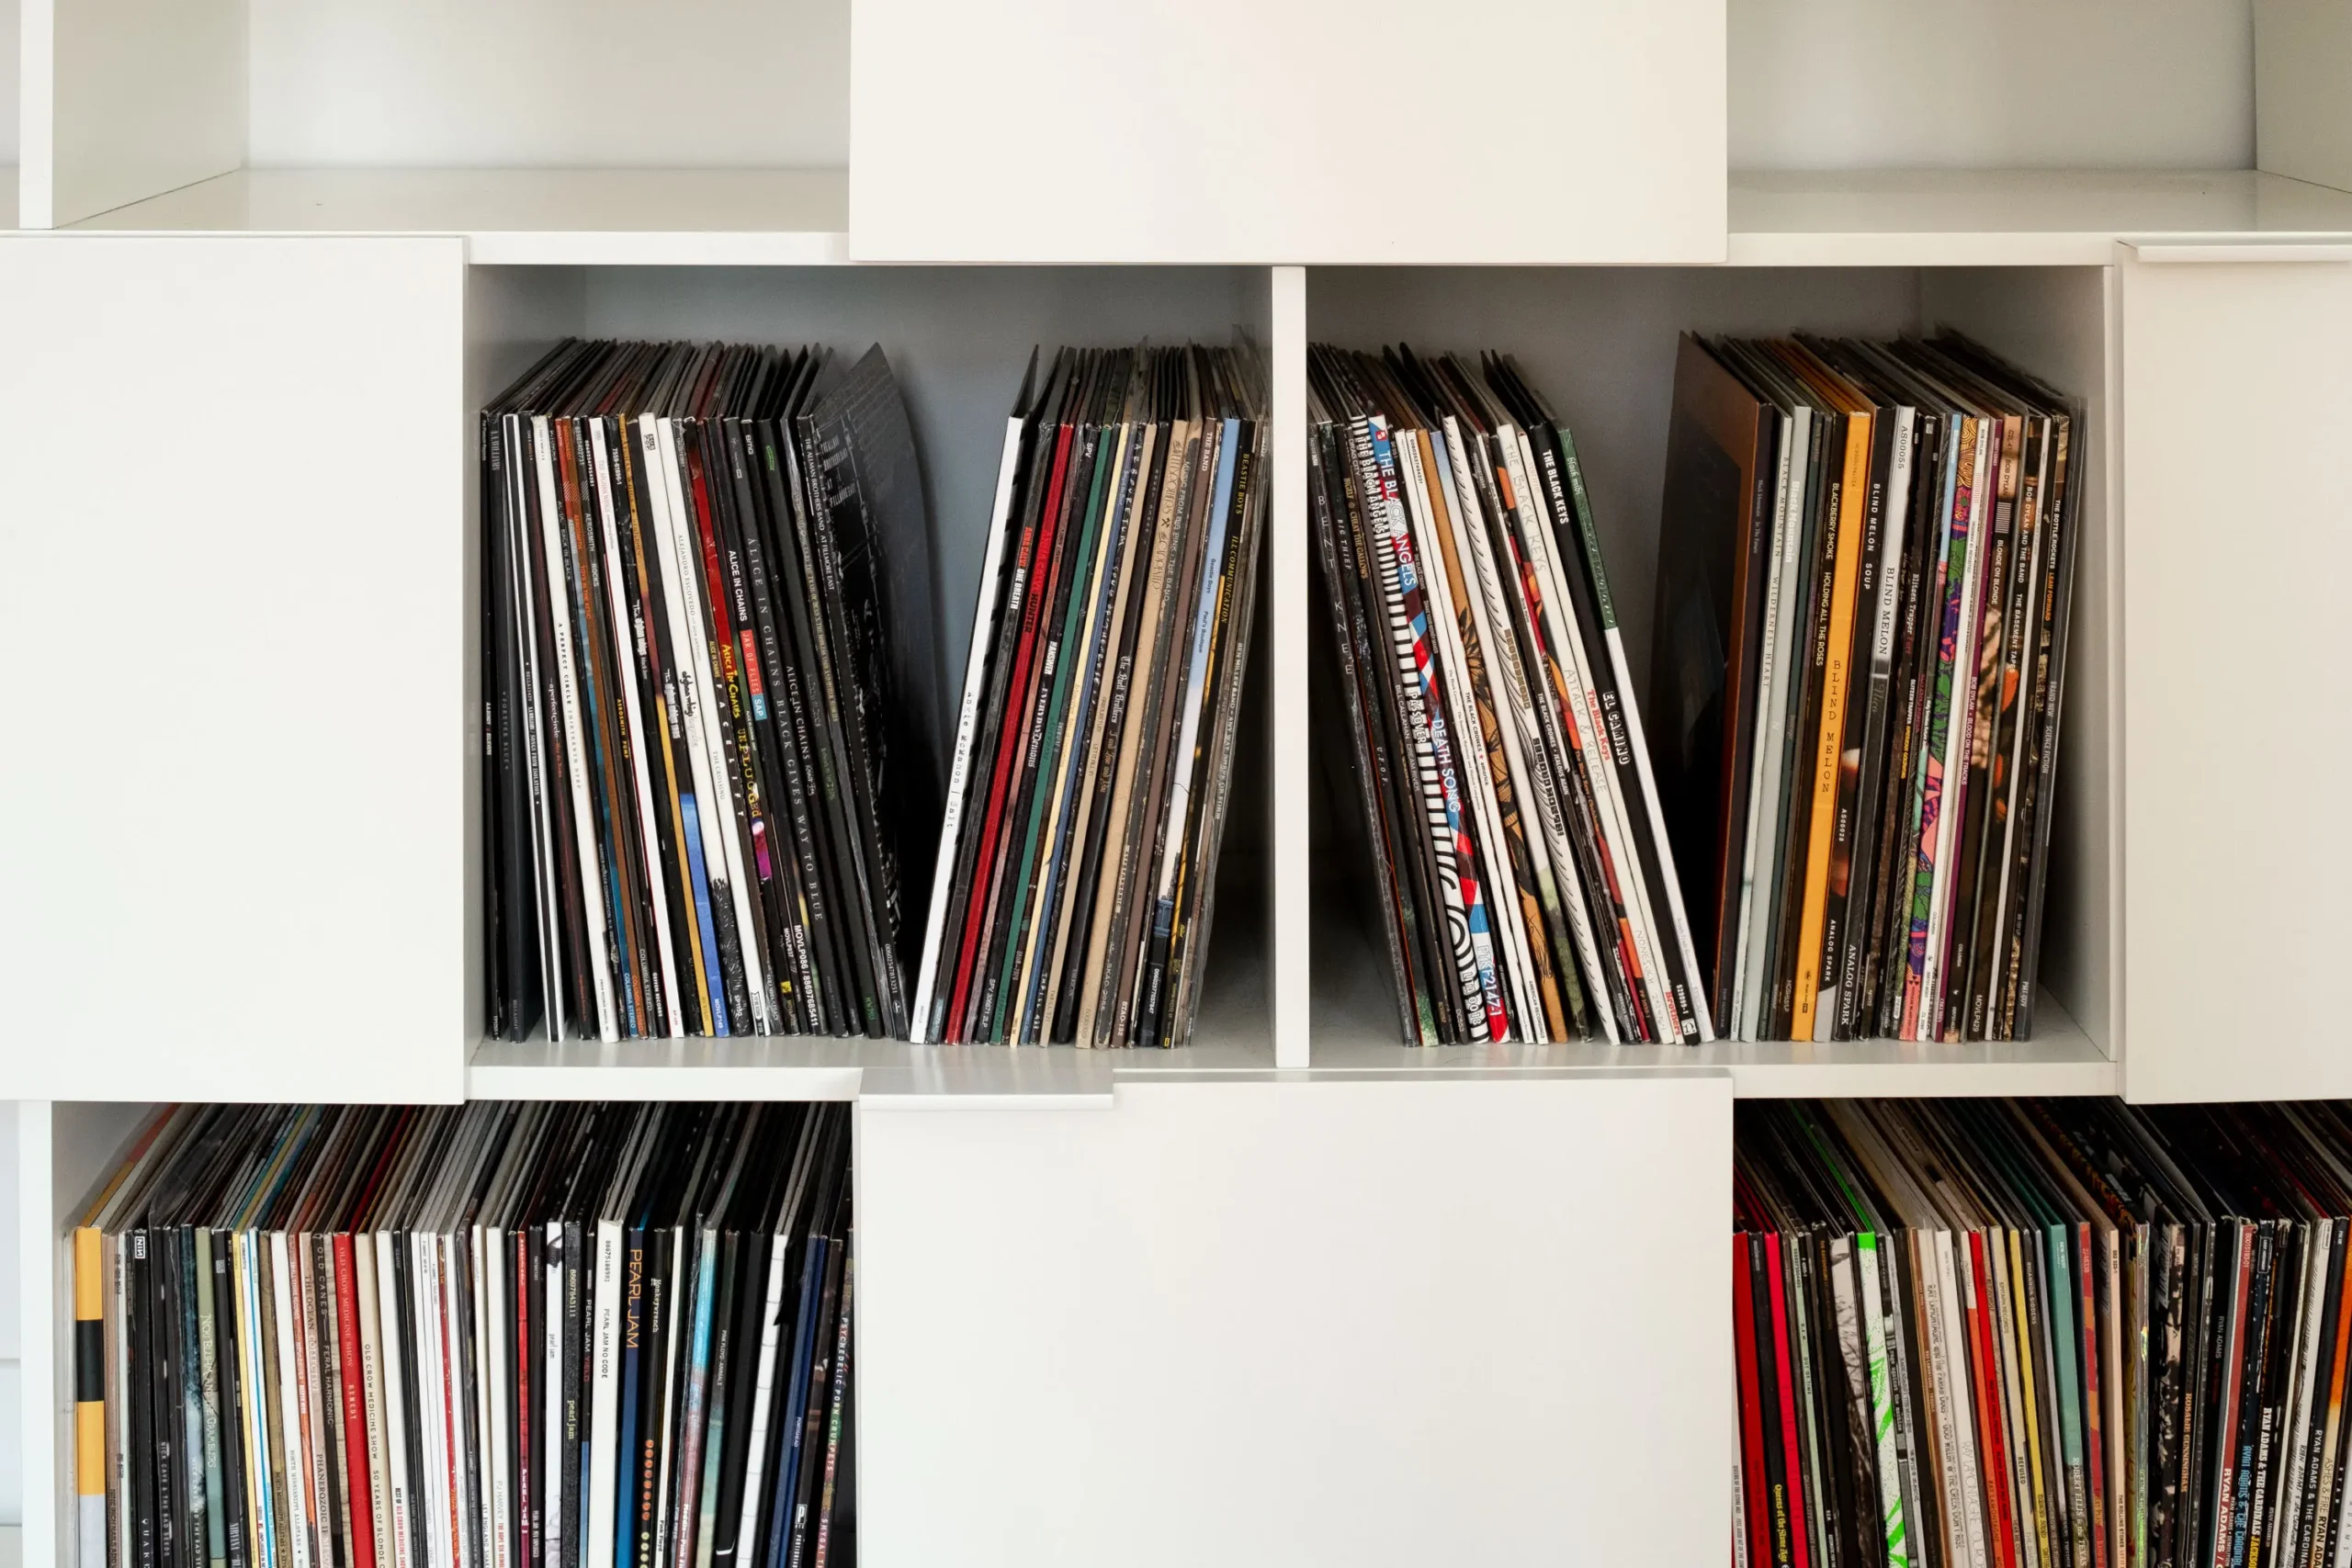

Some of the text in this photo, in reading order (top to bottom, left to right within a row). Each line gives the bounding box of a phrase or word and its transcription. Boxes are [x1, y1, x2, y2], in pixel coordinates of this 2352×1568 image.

[808, 451, 816, 477] ALLMAN
[1349, 438, 1361, 476] DRAG CITY
[1898, 425, 1907, 469] AS00055
[1238, 453, 1250, 491] BEASTIE
[1543, 450, 1569, 525] THE BLACK KEYS
[811, 478, 821, 511] BROTHERS
[1236, 492, 1245, 515] BOYS
[585, 513, 594, 551] AEROSMITH
[817, 512, 825, 531] BAND
[1379, 450, 1415, 586] THE BLACK ANGELS
[1864, 482, 1880, 590] BLIND MELON SOUP
[821, 544, 831, 575] FILLMORE
[1011, 527, 1033, 609] ANNA CALVI ONE BREATH
[1815, 482, 1838, 666] BLACKBERRY SMOKE HOLDING ALL THE ROSES
[1992, 539, 2004, 604] BLONDE ON BLONDE
[1221, 550, 1236, 624] COMMUNICATION
[2045, 589, 2053, 621] FORWARD
[1880, 568, 1895, 655] BLIND MELON
[729, 550, 764, 716] ALICE IN CHAINS JAR OF FLIES SAP
[1198, 628, 1206, 653] Boutique
[617, 698, 626, 736] AEROSMITH
[748, 538, 823, 921] ALICE IN CHAINS BLACK GIVES WAY TO BLUE
[1397, 698, 1410, 739] CALLAHAN
[1408, 693, 1427, 743] PASSOVER
[1541, 705, 1551, 723] BLACK
[1586, 690, 1611, 761] The Black Keys
[1602, 692, 1630, 765] EL CAMINO
[1823, 660, 1842, 793] BLIND MELON
[1406, 743, 1415, 767] DREAM
[1545, 724, 1556, 747] CROWES
[2044, 726, 2053, 750] SCIENCE
[1410, 768, 1419, 792] RIVER
[1431, 718, 1461, 812] DEATH SONG
[1553, 754, 1565, 776] JEALOUS
[2042, 751, 2051, 773] FICTION
[1559, 778, 1569, 795] AGAIN
[794, 925, 820, 1026] MOVLP086 88697685411
[1841, 944, 1856, 1025] ANALOG SPARK
[1118, 1001, 1127, 1036] STAO-132
[1665, 991, 1682, 1036] Brothers
[1973, 994, 1983, 1032] MOVLP429
[343, 1296, 352, 1339] MEDICINE
[628, 1249, 641, 1348] PEARL JAM
[652, 1279, 662, 1333] Monkeywrench
[305, 1275, 318, 1393] THE OCEAN COLLECTIVE
[320, 1275, 328, 1315] CANES
[326, 1376, 334, 1425] HARMONIC
[836, 1318, 847, 1385] PSYCHEDELIC
[794, 1416, 802, 1447] PORTISHEAD
[2261, 1407, 2271, 1430] RYAN
[828, 1420, 838, 1472] CRUMPETS
[2181, 1393, 2192, 1493] ROSALIE CUNNINGHAM
[2258, 1432, 2269, 1461] ADAMS
[2072, 1458, 2083, 1494] ROBERT
[2256, 1471, 2267, 1488] THE
[2323, 1458, 2334, 1484] ASHES
[1773, 1484, 1789, 1562] Queens of the Stone Age
[2075, 1495, 2085, 1516] ELLIS
[2218, 1468, 2232, 1551] RYAN ADAMS
[2252, 1488, 2265, 1535] CARDINALS
[2320, 1495, 2330, 1513] FIRE
[2077, 1526, 2086, 1538] the
[2078, 1540, 2088, 1566] TEXAS
